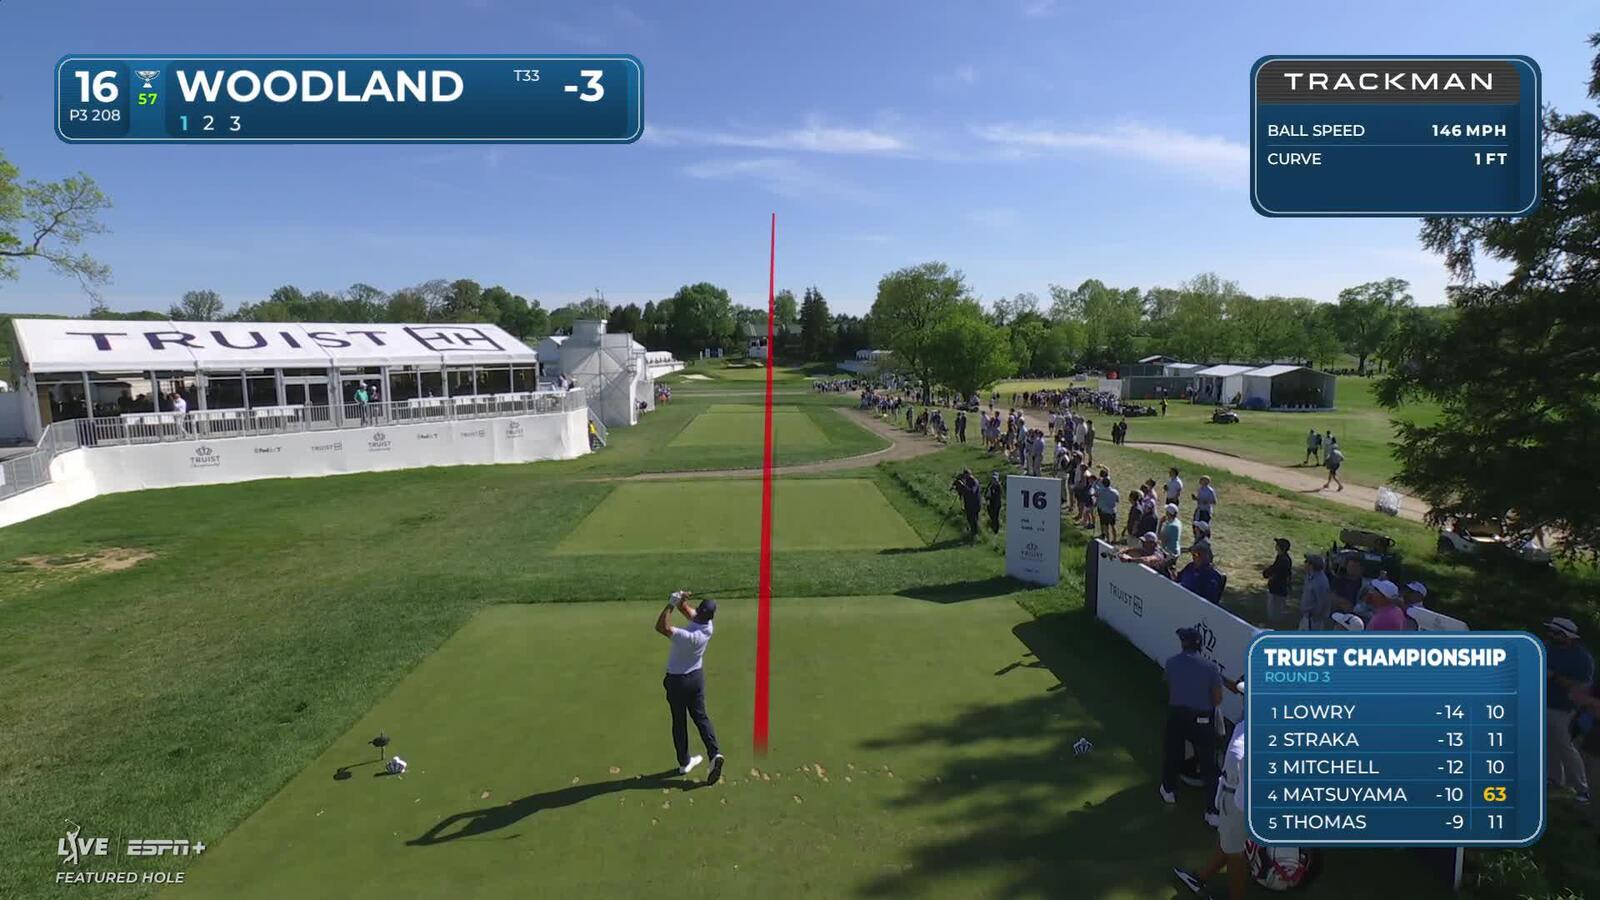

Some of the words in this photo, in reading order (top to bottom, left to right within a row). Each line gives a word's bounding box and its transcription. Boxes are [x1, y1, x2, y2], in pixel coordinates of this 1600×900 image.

[66, 331, 387, 351] TRUIST
[190, 455, 220, 464] TRUIST
[1021, 490, 1047, 510] 16
[1110, 582, 1132, 606] TRUIST
